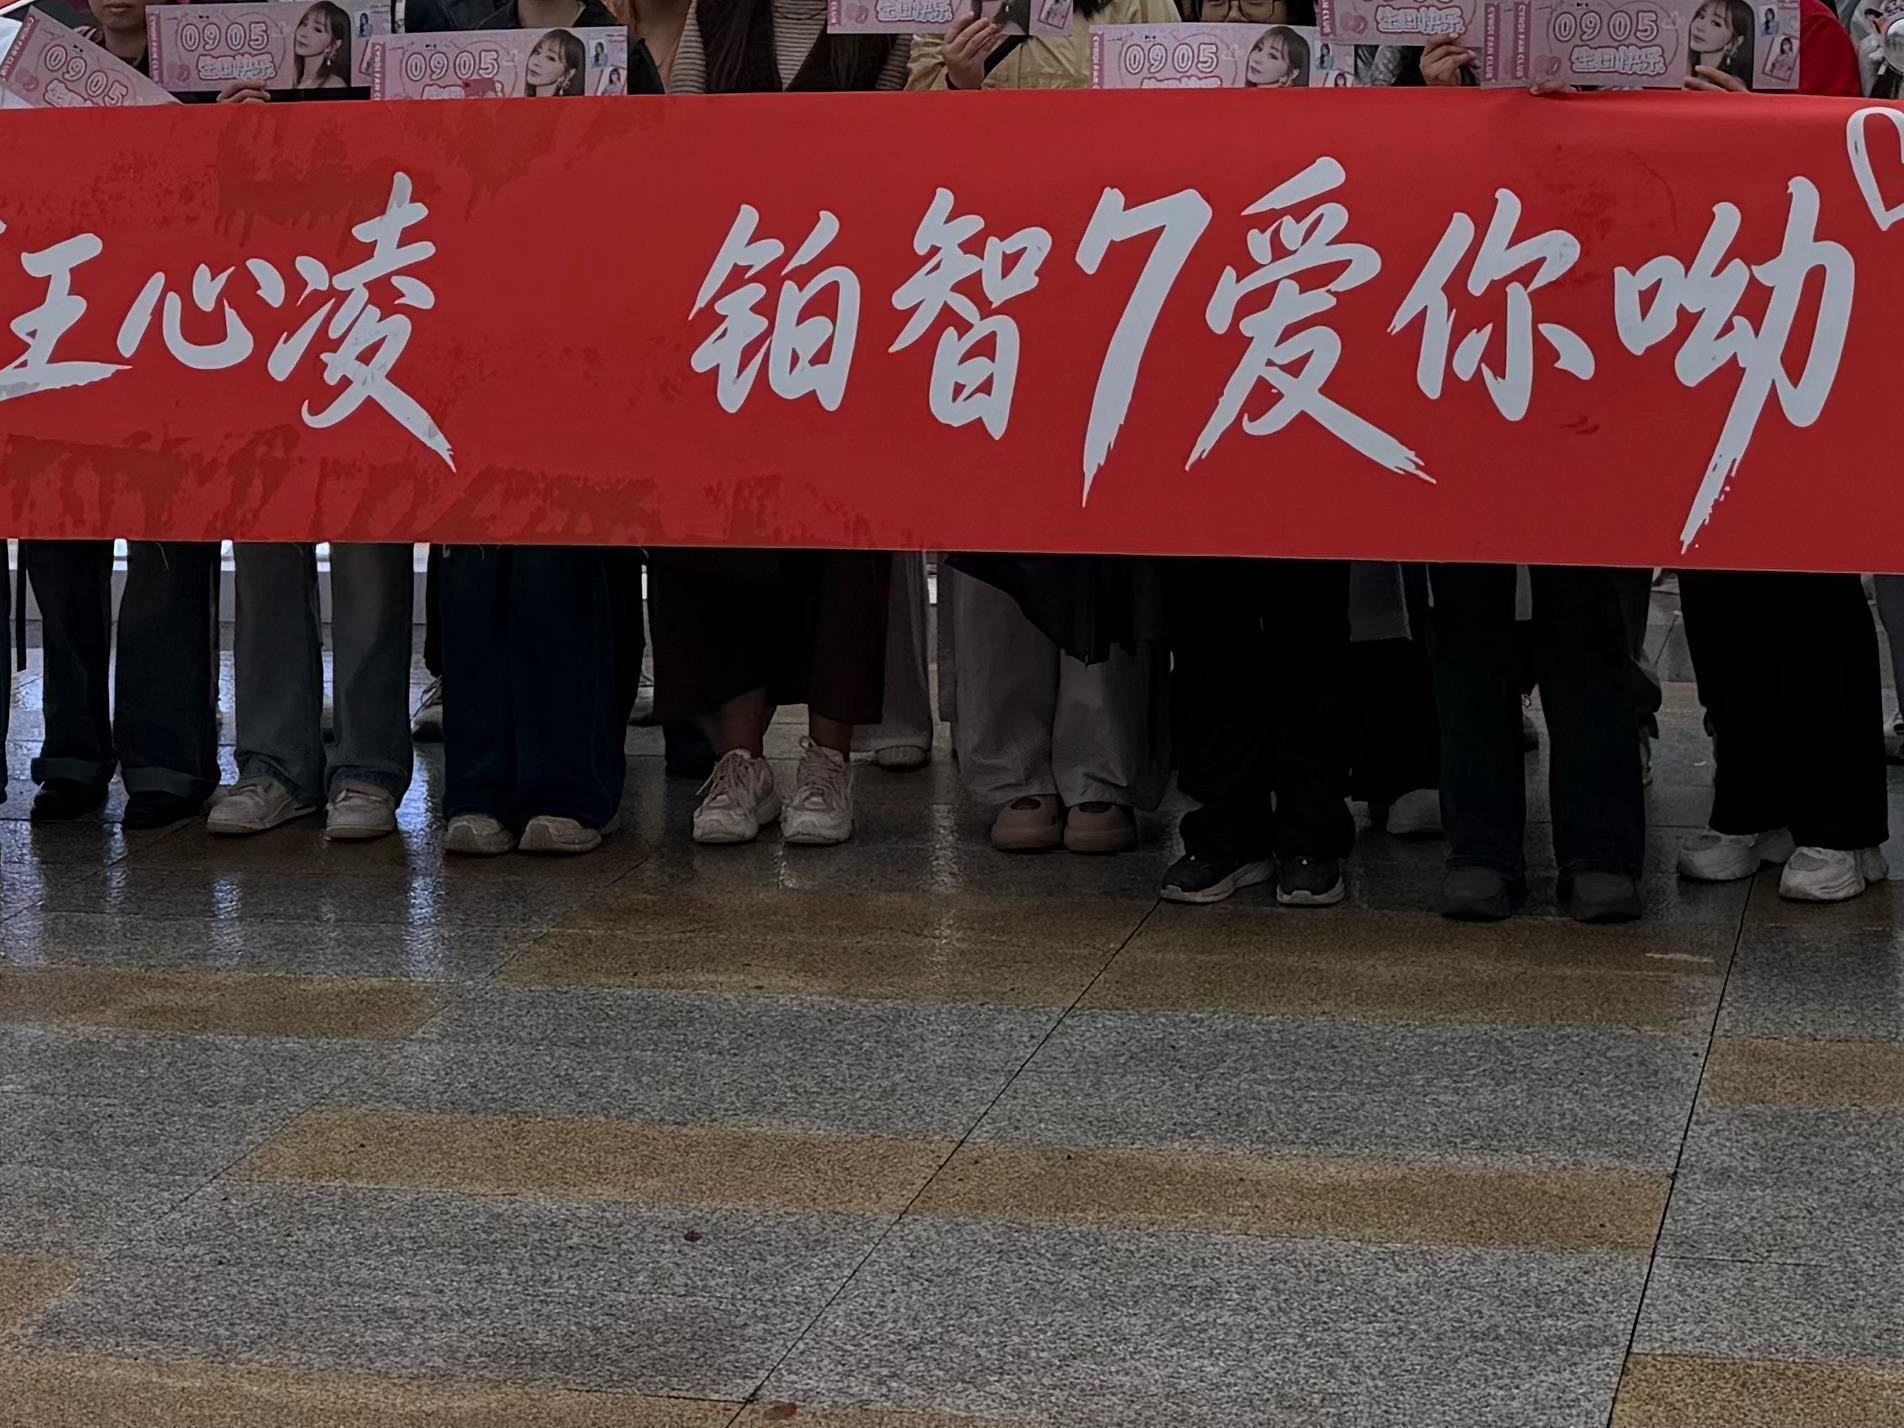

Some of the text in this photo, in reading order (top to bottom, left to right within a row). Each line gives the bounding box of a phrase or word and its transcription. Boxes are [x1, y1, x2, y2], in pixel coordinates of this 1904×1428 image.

[1375, 5, 1467, 35] 生日快乐
[1553, 10, 1660, 43] 0905
[180, 21, 269, 52] 0905
[1486, 36, 1494, 54] FAN
[1516, 34, 1525, 52] FAN
[405, 49, 499, 82] 0905
[1124, 43, 1219, 75] 0905
[1485, 55, 1493, 79] CLUB
[1515, 54, 1524, 76] CLUB
[1570, 44, 1668, 75] 生日快乐
[45, 44, 129, 107] 0905
[689, 157, 1856, 553] 铂智7爱你呦
